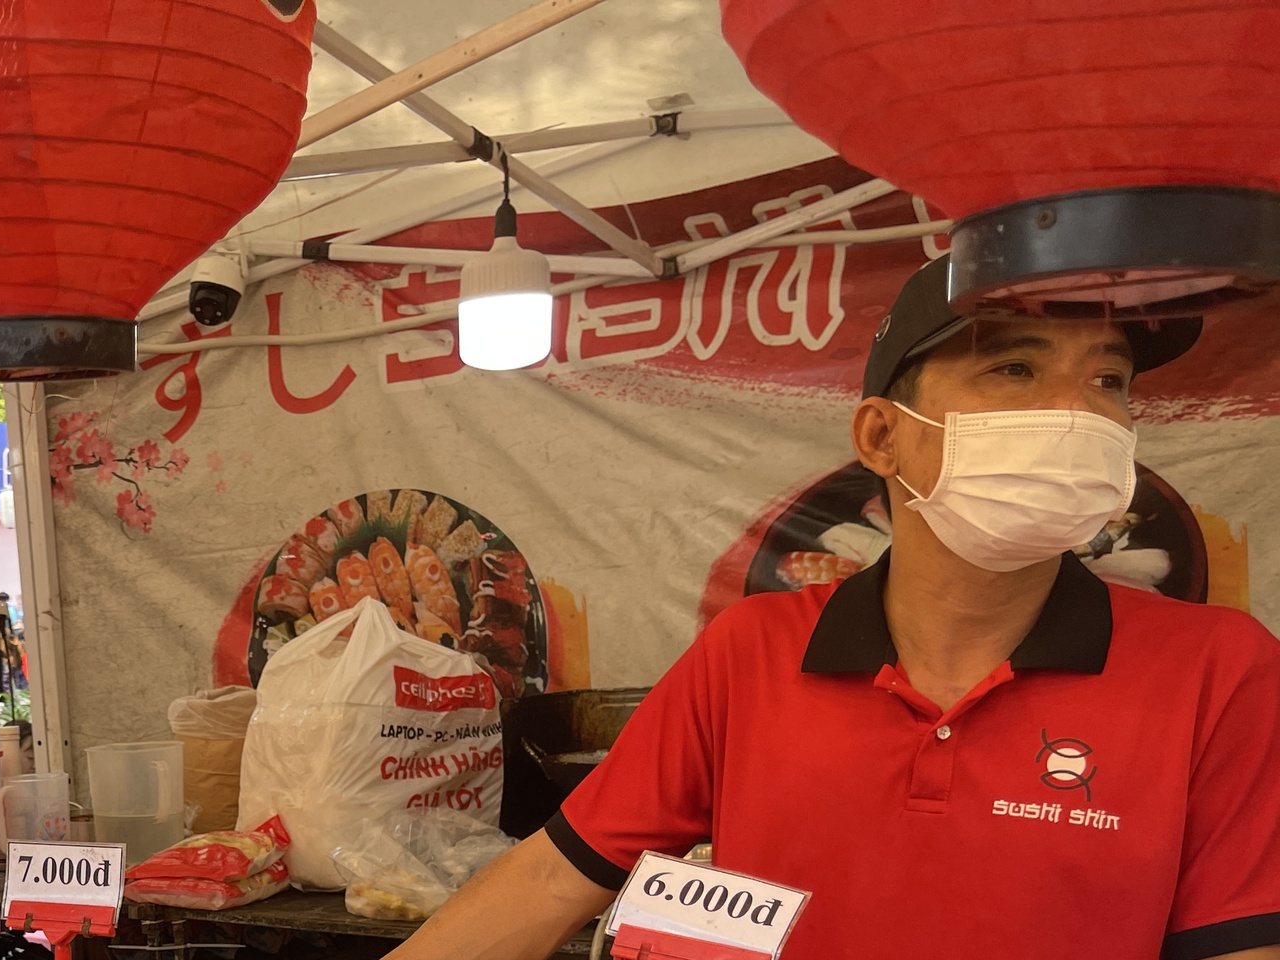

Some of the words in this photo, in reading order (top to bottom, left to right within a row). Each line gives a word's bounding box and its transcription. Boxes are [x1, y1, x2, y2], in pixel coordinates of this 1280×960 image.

[380, 724, 424, 741] LAPTOP
[380, 751, 450, 780] CHÍNH
[18, 855, 112, 887] 7.000đ
[641, 871, 784, 928] 6.000đ
